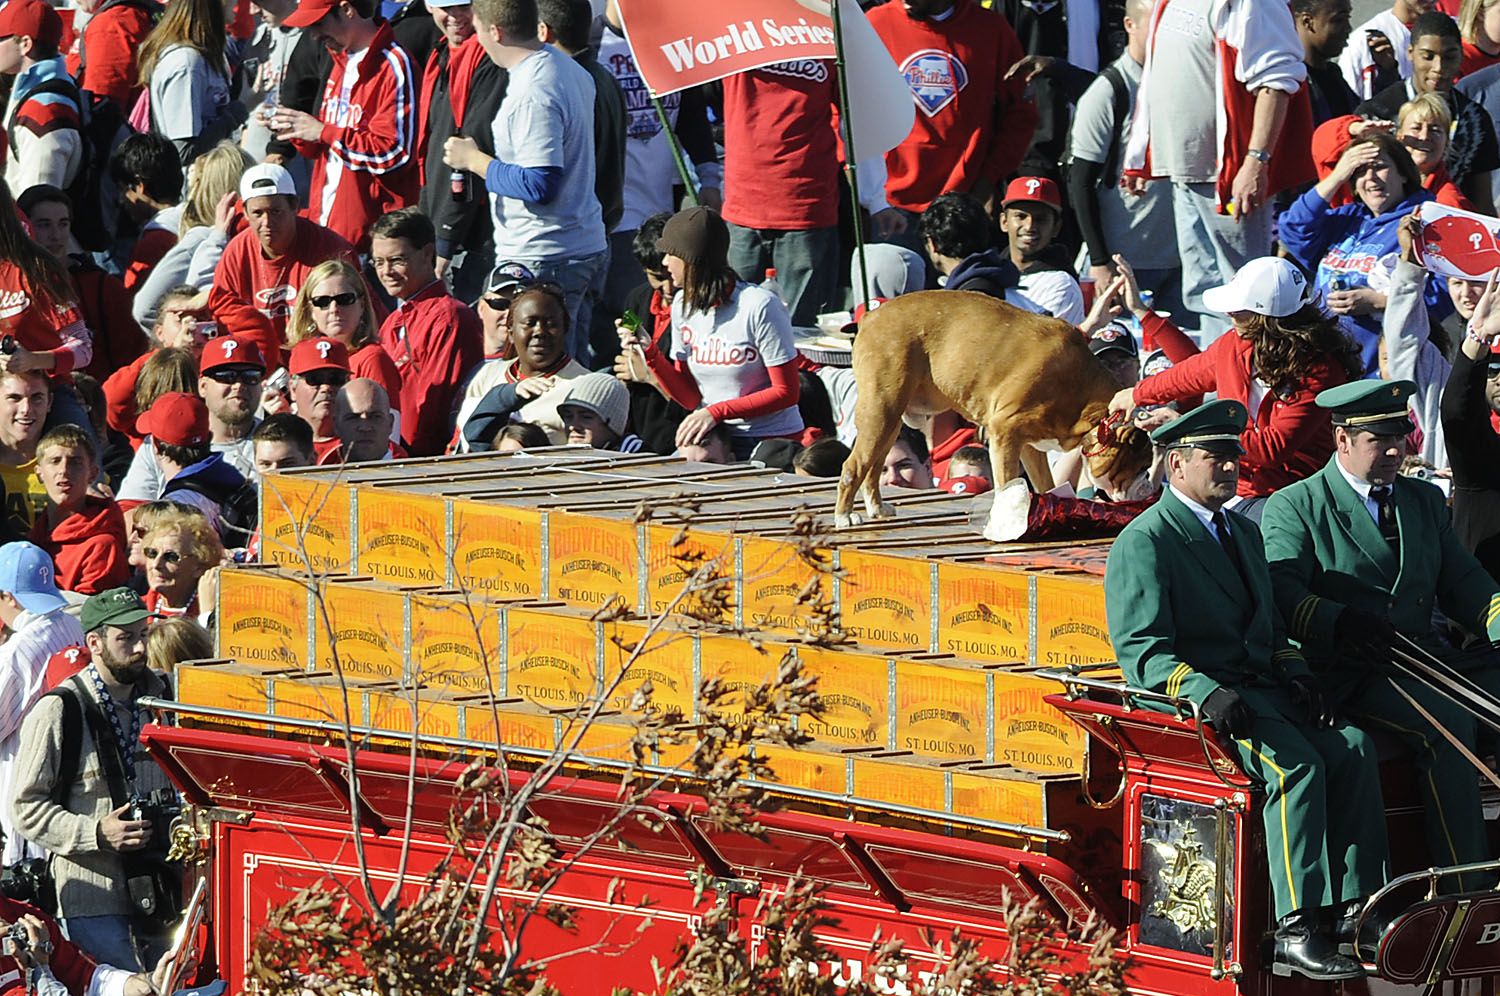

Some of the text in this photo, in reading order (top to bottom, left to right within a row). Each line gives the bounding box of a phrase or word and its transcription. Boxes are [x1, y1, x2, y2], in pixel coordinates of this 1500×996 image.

[660, 20, 764, 73] World
[762, 18, 835, 48] Series
[1025, 178, 1041, 196] P
[1468, 232, 1483, 249] P
[221, 340, 239, 359] P
[316, 341, 331, 360] P
[680, 326, 758, 366] Phillies
[553, 527, 633, 578] BUDWEISER
[367, 562, 382, 575] ST.
[384, 564, 417, 579] LOUIS.
[479, 579, 512, 593] LOUIS.
[867, 628, 901, 643] LOUIS.
[64, 648, 80, 664] P
[965, 641, 999, 655] LOUIS.
[923, 739, 957, 754] LOUIS.
[1021, 751, 1055, 765] LOUIS.
